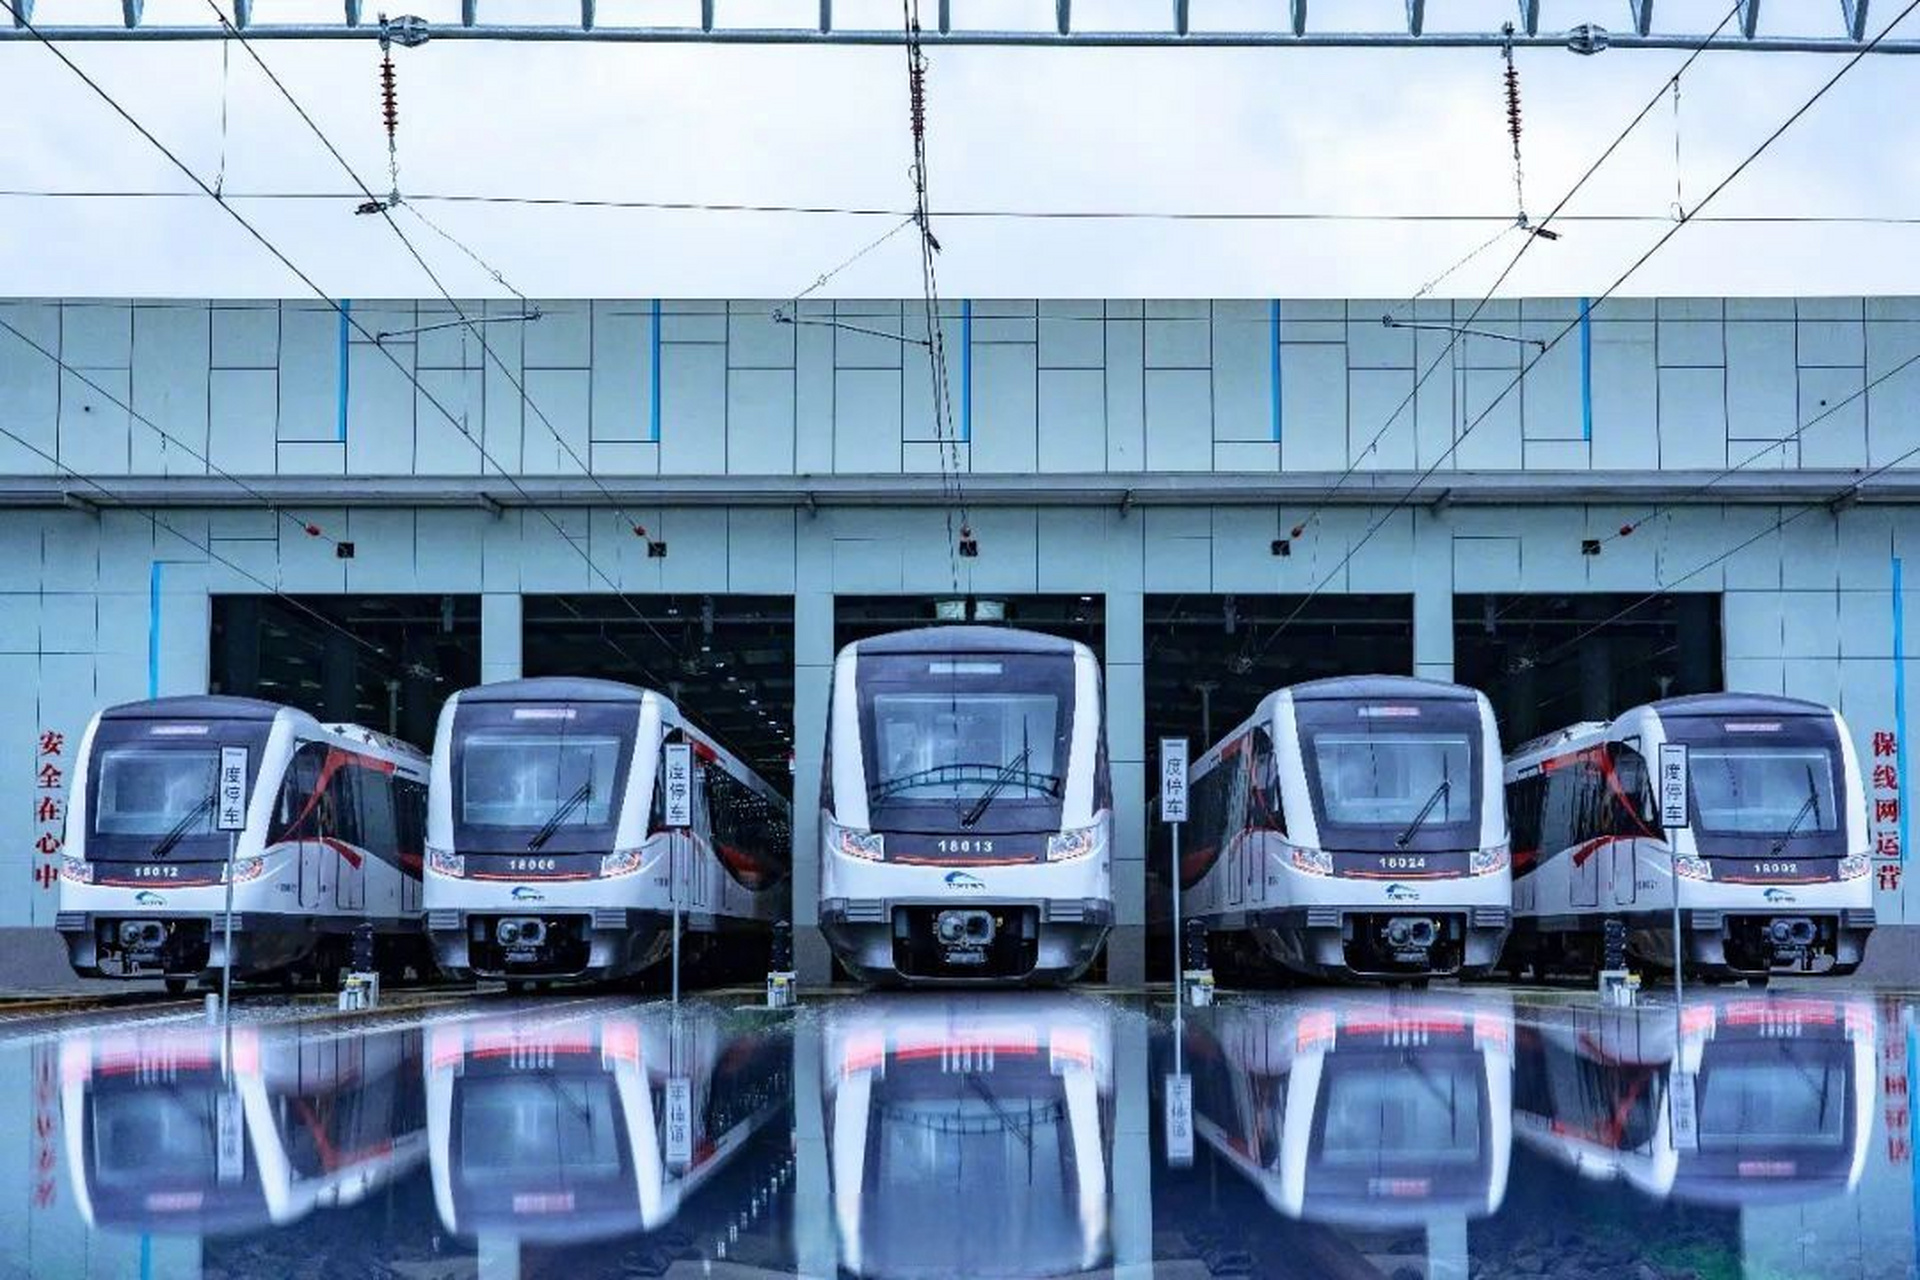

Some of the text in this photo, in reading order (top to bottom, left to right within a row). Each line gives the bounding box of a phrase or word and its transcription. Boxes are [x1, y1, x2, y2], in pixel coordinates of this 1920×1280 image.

[35, 730, 63, 889] 安全在心中
[1166, 743, 1184, 816] 一度停车
[1665, 748, 1682, 822] 一度停车
[1872, 731, 1901, 891] 保线网运营
[134, 866, 179, 878] 18012
[938, 840, 993, 853] 18013
[1379, 858, 1425, 869] 18024
